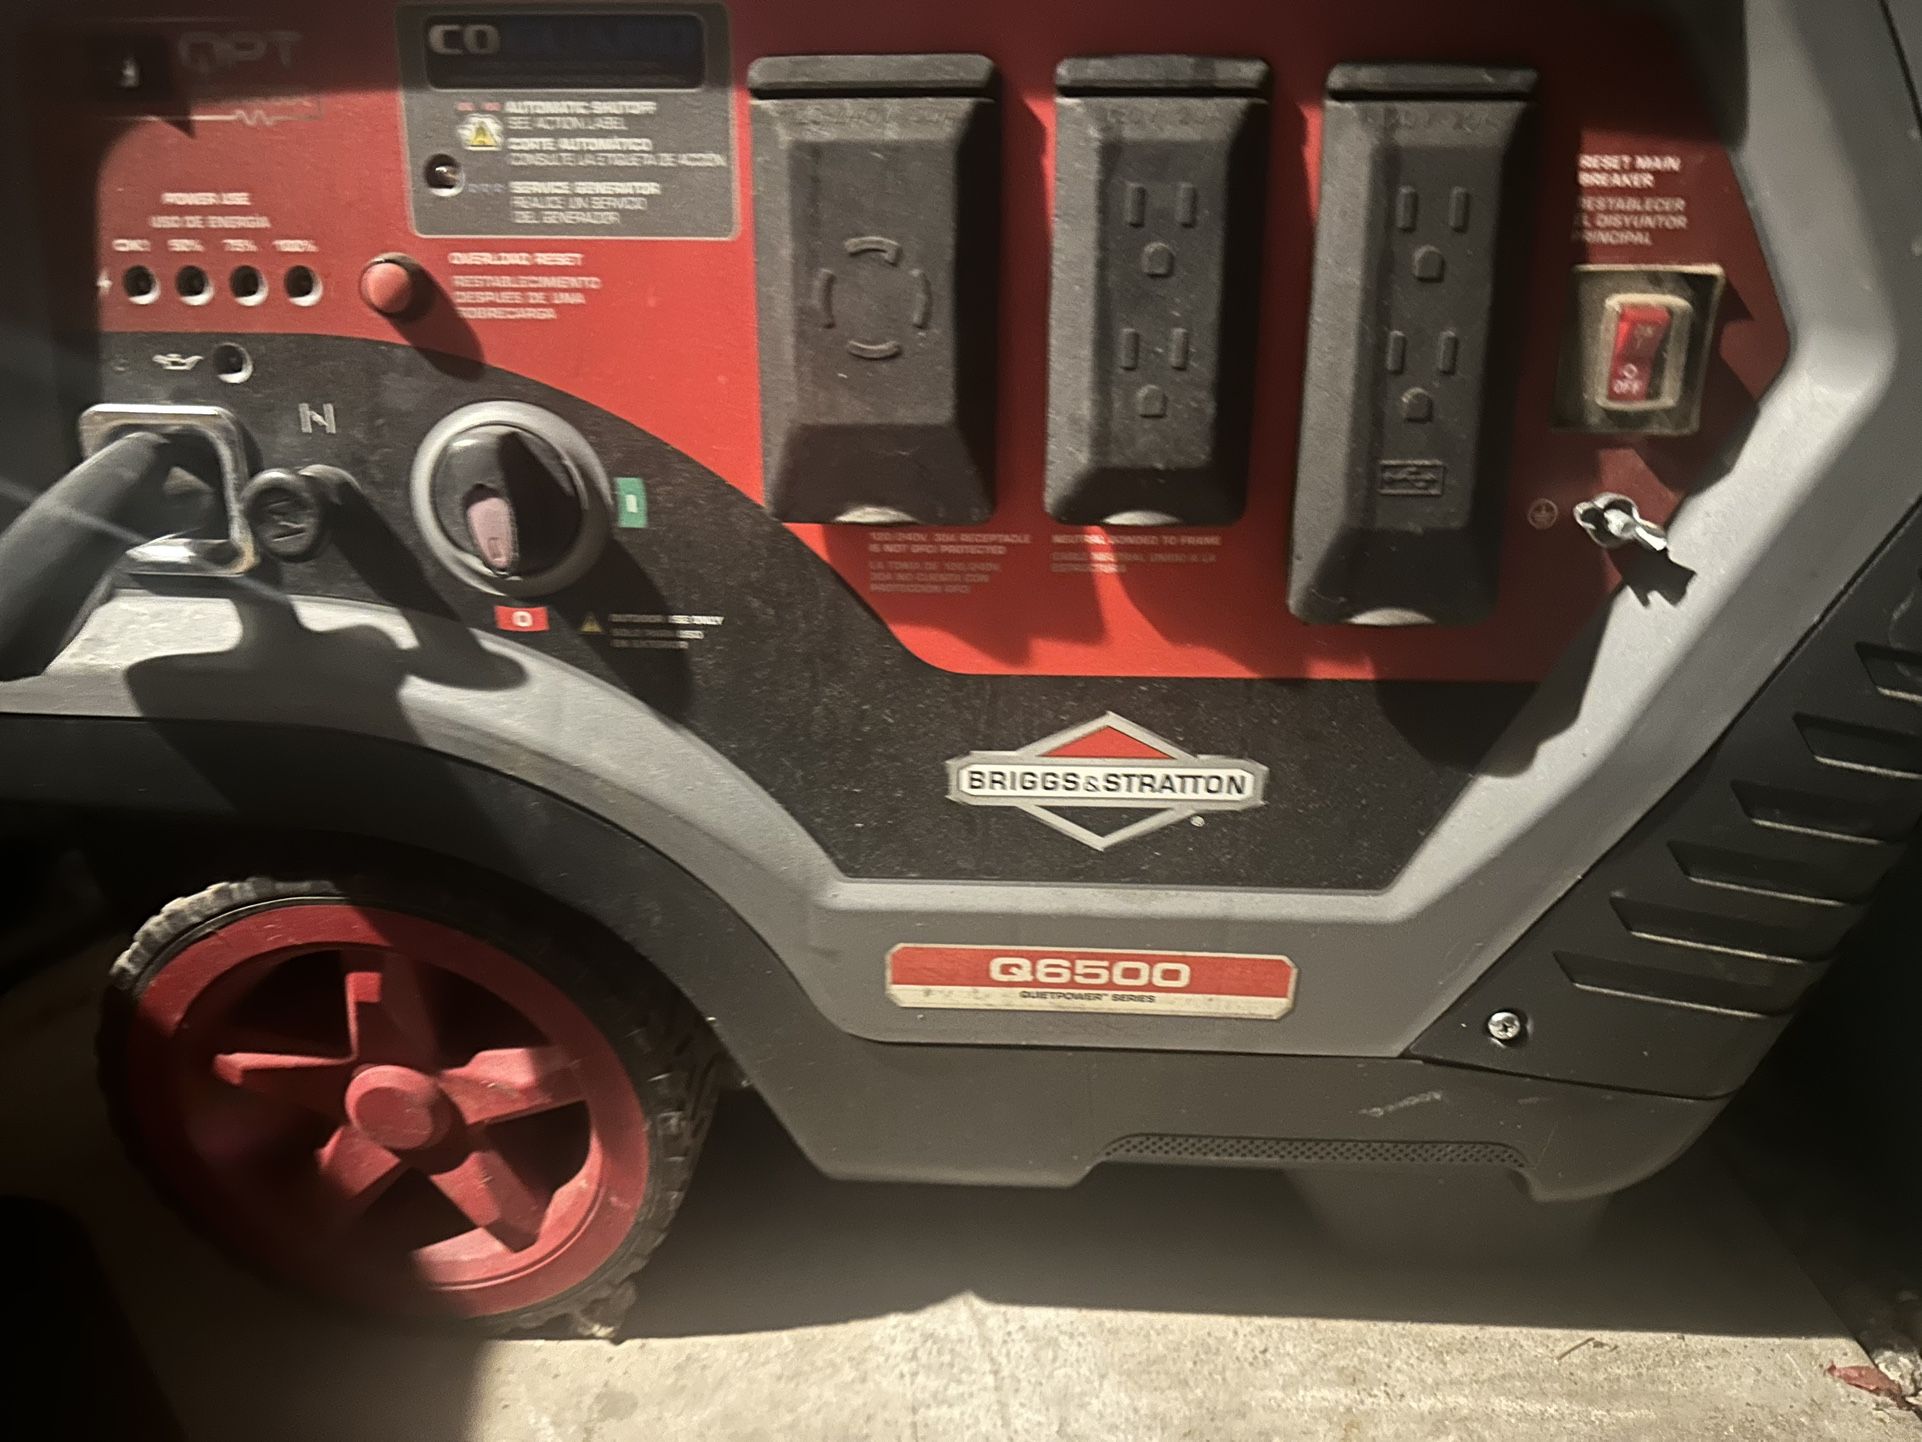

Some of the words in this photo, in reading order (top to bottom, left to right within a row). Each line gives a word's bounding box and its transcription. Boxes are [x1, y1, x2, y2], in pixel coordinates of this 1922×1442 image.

[428, 24, 499, 54] CO
[1634, 154, 1681, 171] MAIN
[989, 956, 1191, 988] Q6500
